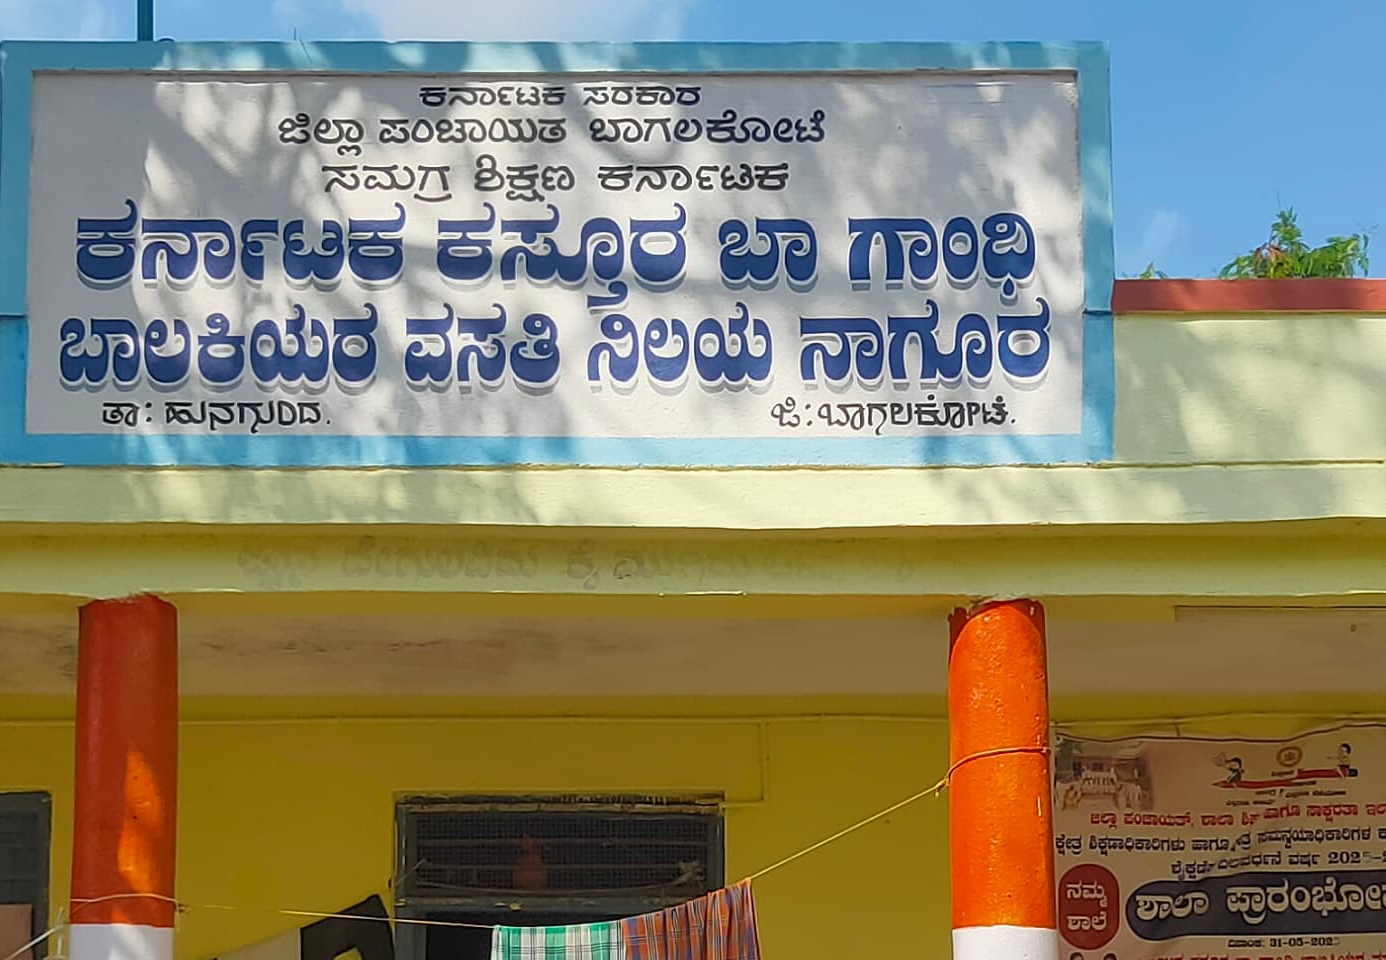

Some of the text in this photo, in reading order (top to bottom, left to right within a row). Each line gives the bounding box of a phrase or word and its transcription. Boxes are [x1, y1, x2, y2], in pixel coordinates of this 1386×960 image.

[418, 85, 702, 108] ಕರ್ನಾಟಕ ಸರಕಾರ
[277, 108, 826, 156] ಜಿಲ್ಲಾ ಪಂಚಾಯತ ಬಾಗಲಕೋಟೆ
[321, 153, 789, 202] ಸಮಗ್ರ ಶಿಕ್ಷಣ ಕರ್ನಾಟಕ
[75, 198, 1037, 310] ಕರ್ನಾಟಕ ಕಸ್ತೂರ ಬಾ ಗಾಂಧಿ
[58, 298, 1053, 388] ಬಾಲಕಿಯರ ವಸತಿ ನಿಲಯ ನಾಗೂರ
[1066, 879, 1109, 907] ನಮ್ಮ
[1135, 889, 1210, 921] ಶಾಲಾ
[1067, 911, 1108, 932] ಶಾಲೆ
